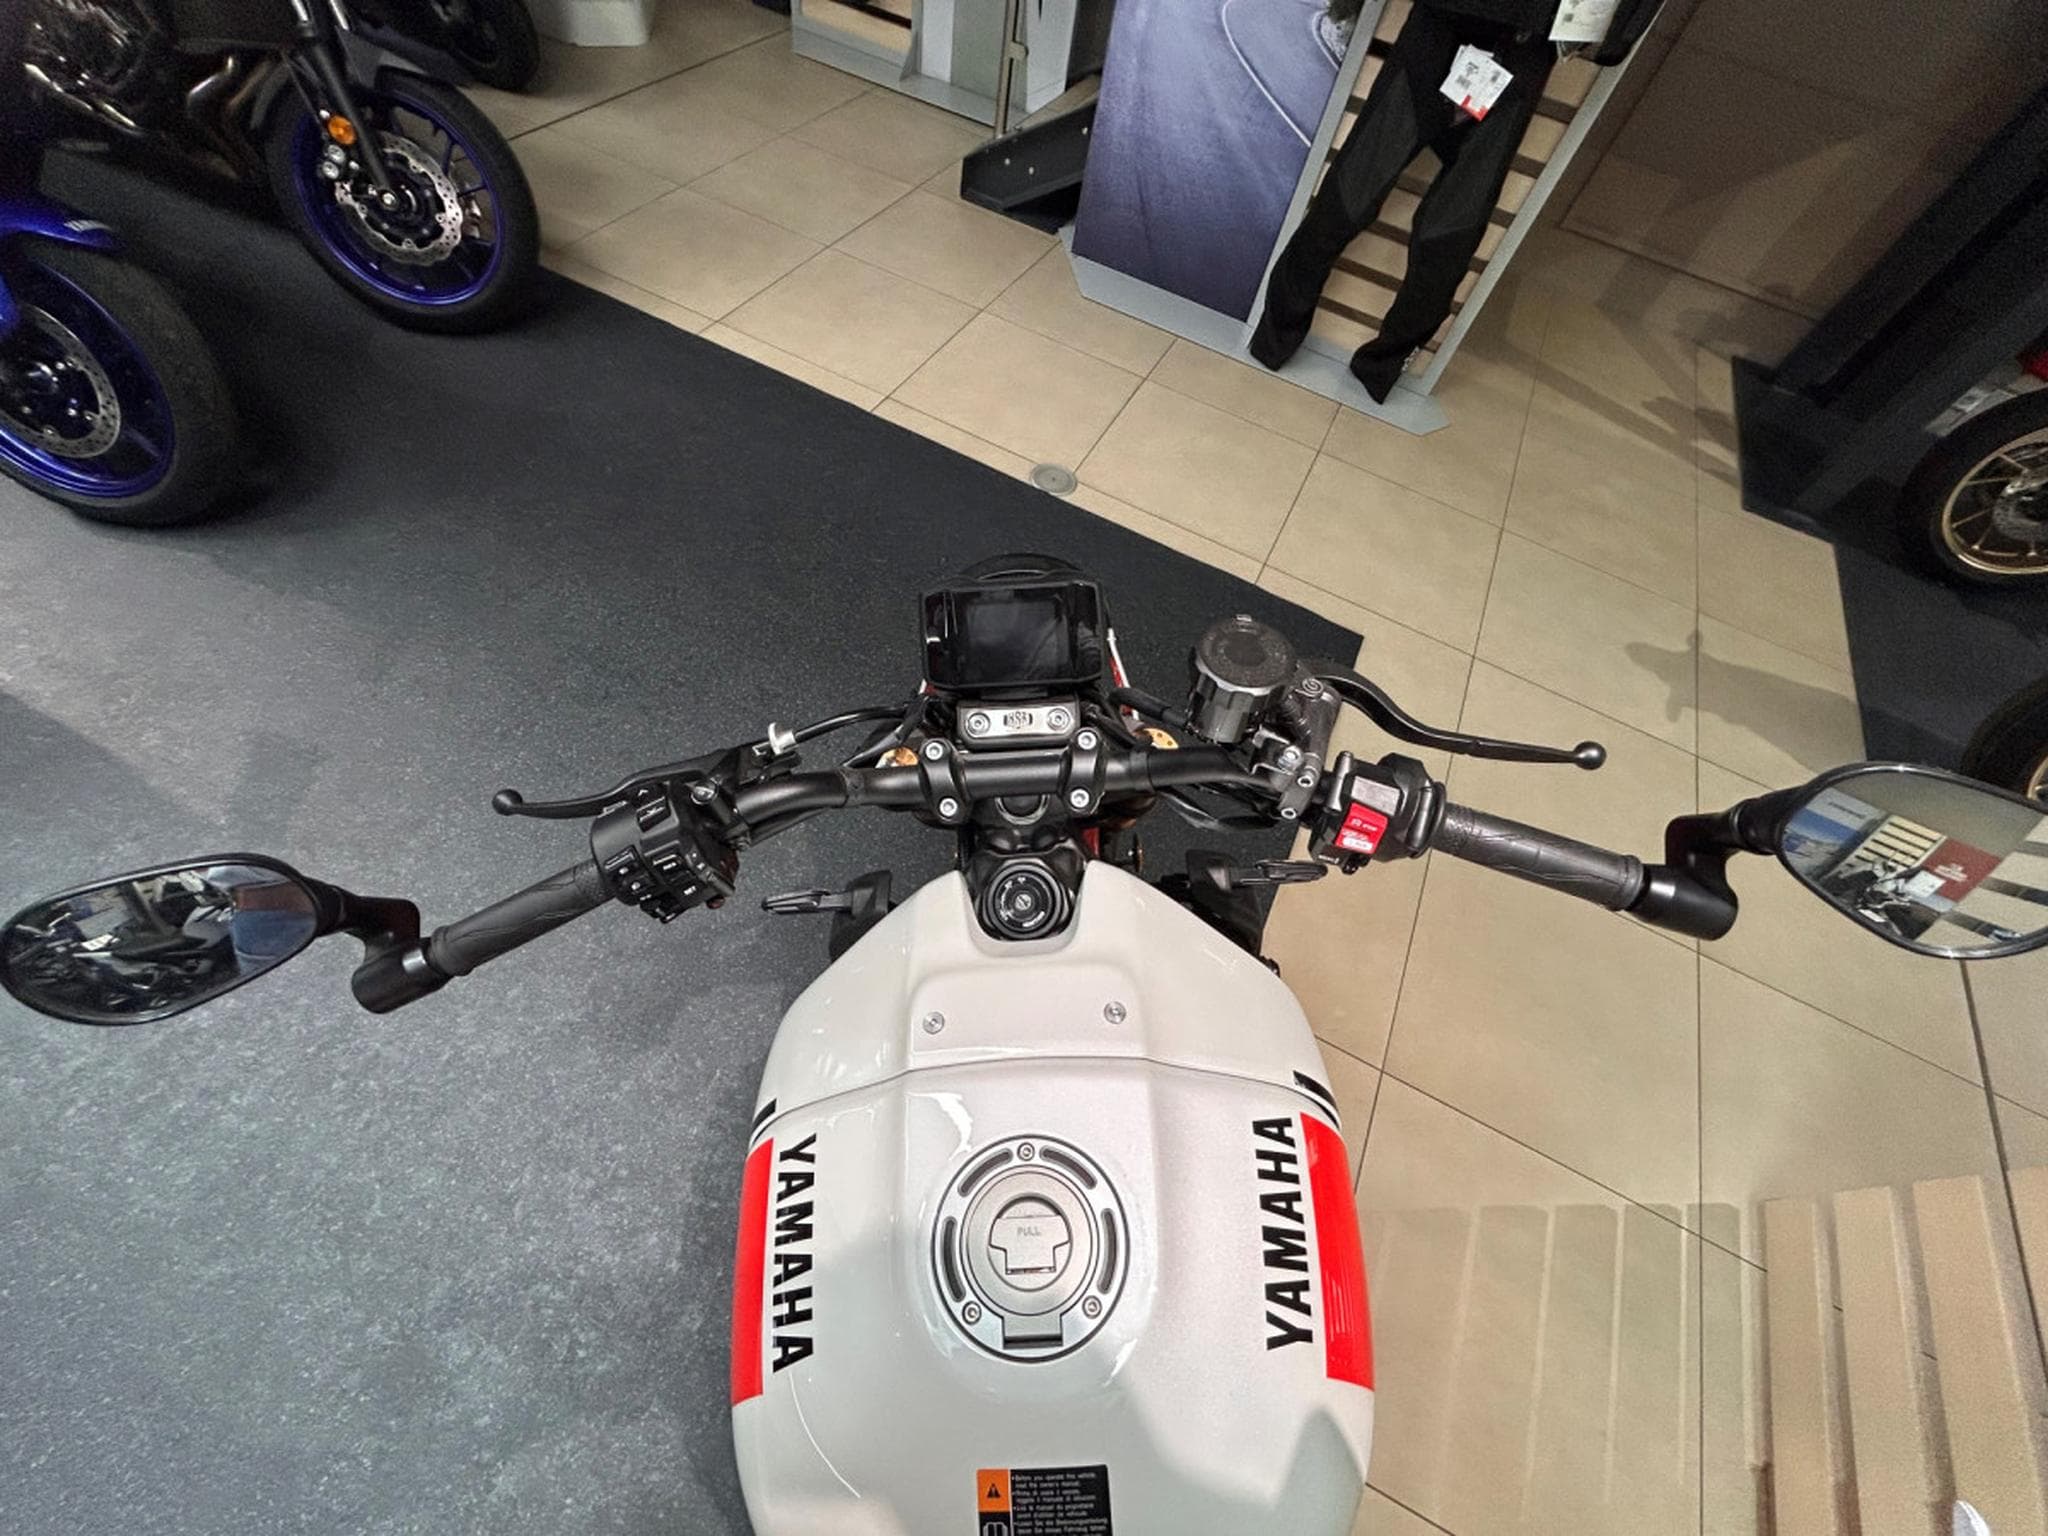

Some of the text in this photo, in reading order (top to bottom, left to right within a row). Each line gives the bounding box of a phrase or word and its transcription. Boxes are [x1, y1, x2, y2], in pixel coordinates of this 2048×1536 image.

[773, 1133, 817, 1373] YAMAHA
[1017, 1226, 1041, 1237] PULL
[1252, 1117, 1313, 1351] YAMAHA
